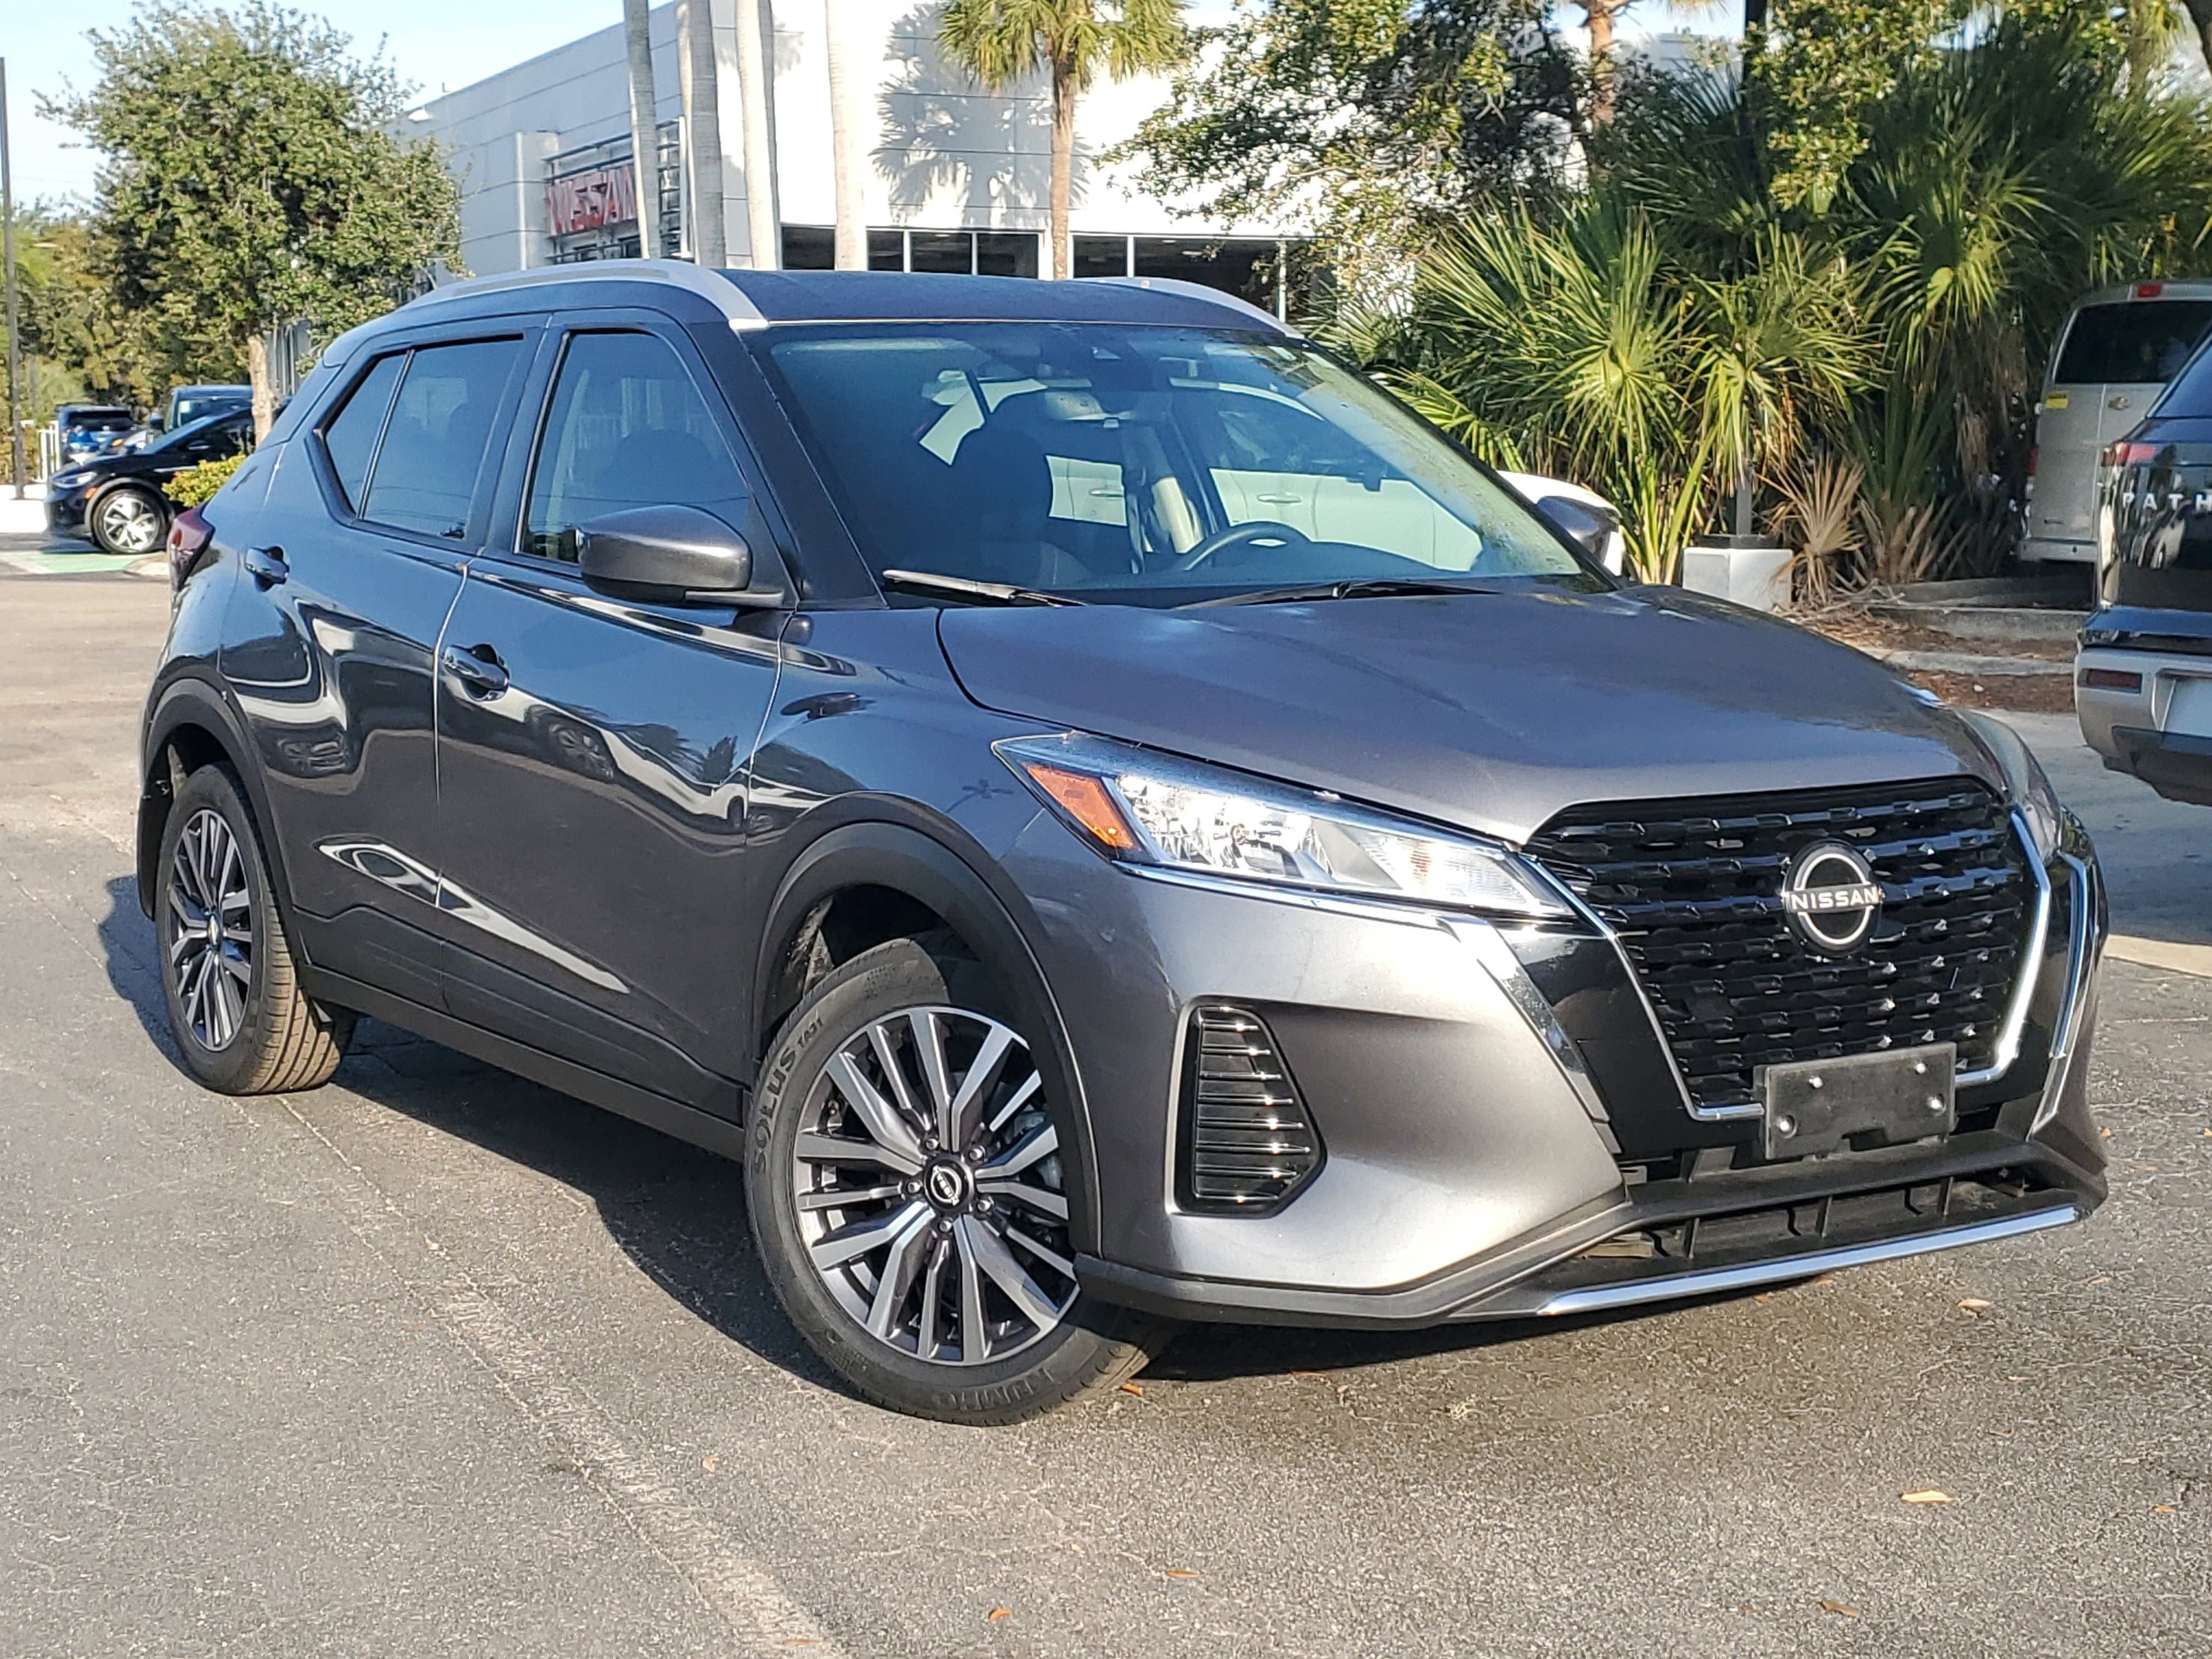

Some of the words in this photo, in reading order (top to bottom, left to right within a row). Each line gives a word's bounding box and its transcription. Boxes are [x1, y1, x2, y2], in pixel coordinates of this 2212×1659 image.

[2123, 492, 2212, 512] PATH
[1790, 886, 1880, 910] NISSAN
[754, 1046, 797, 1175] SOLUS
